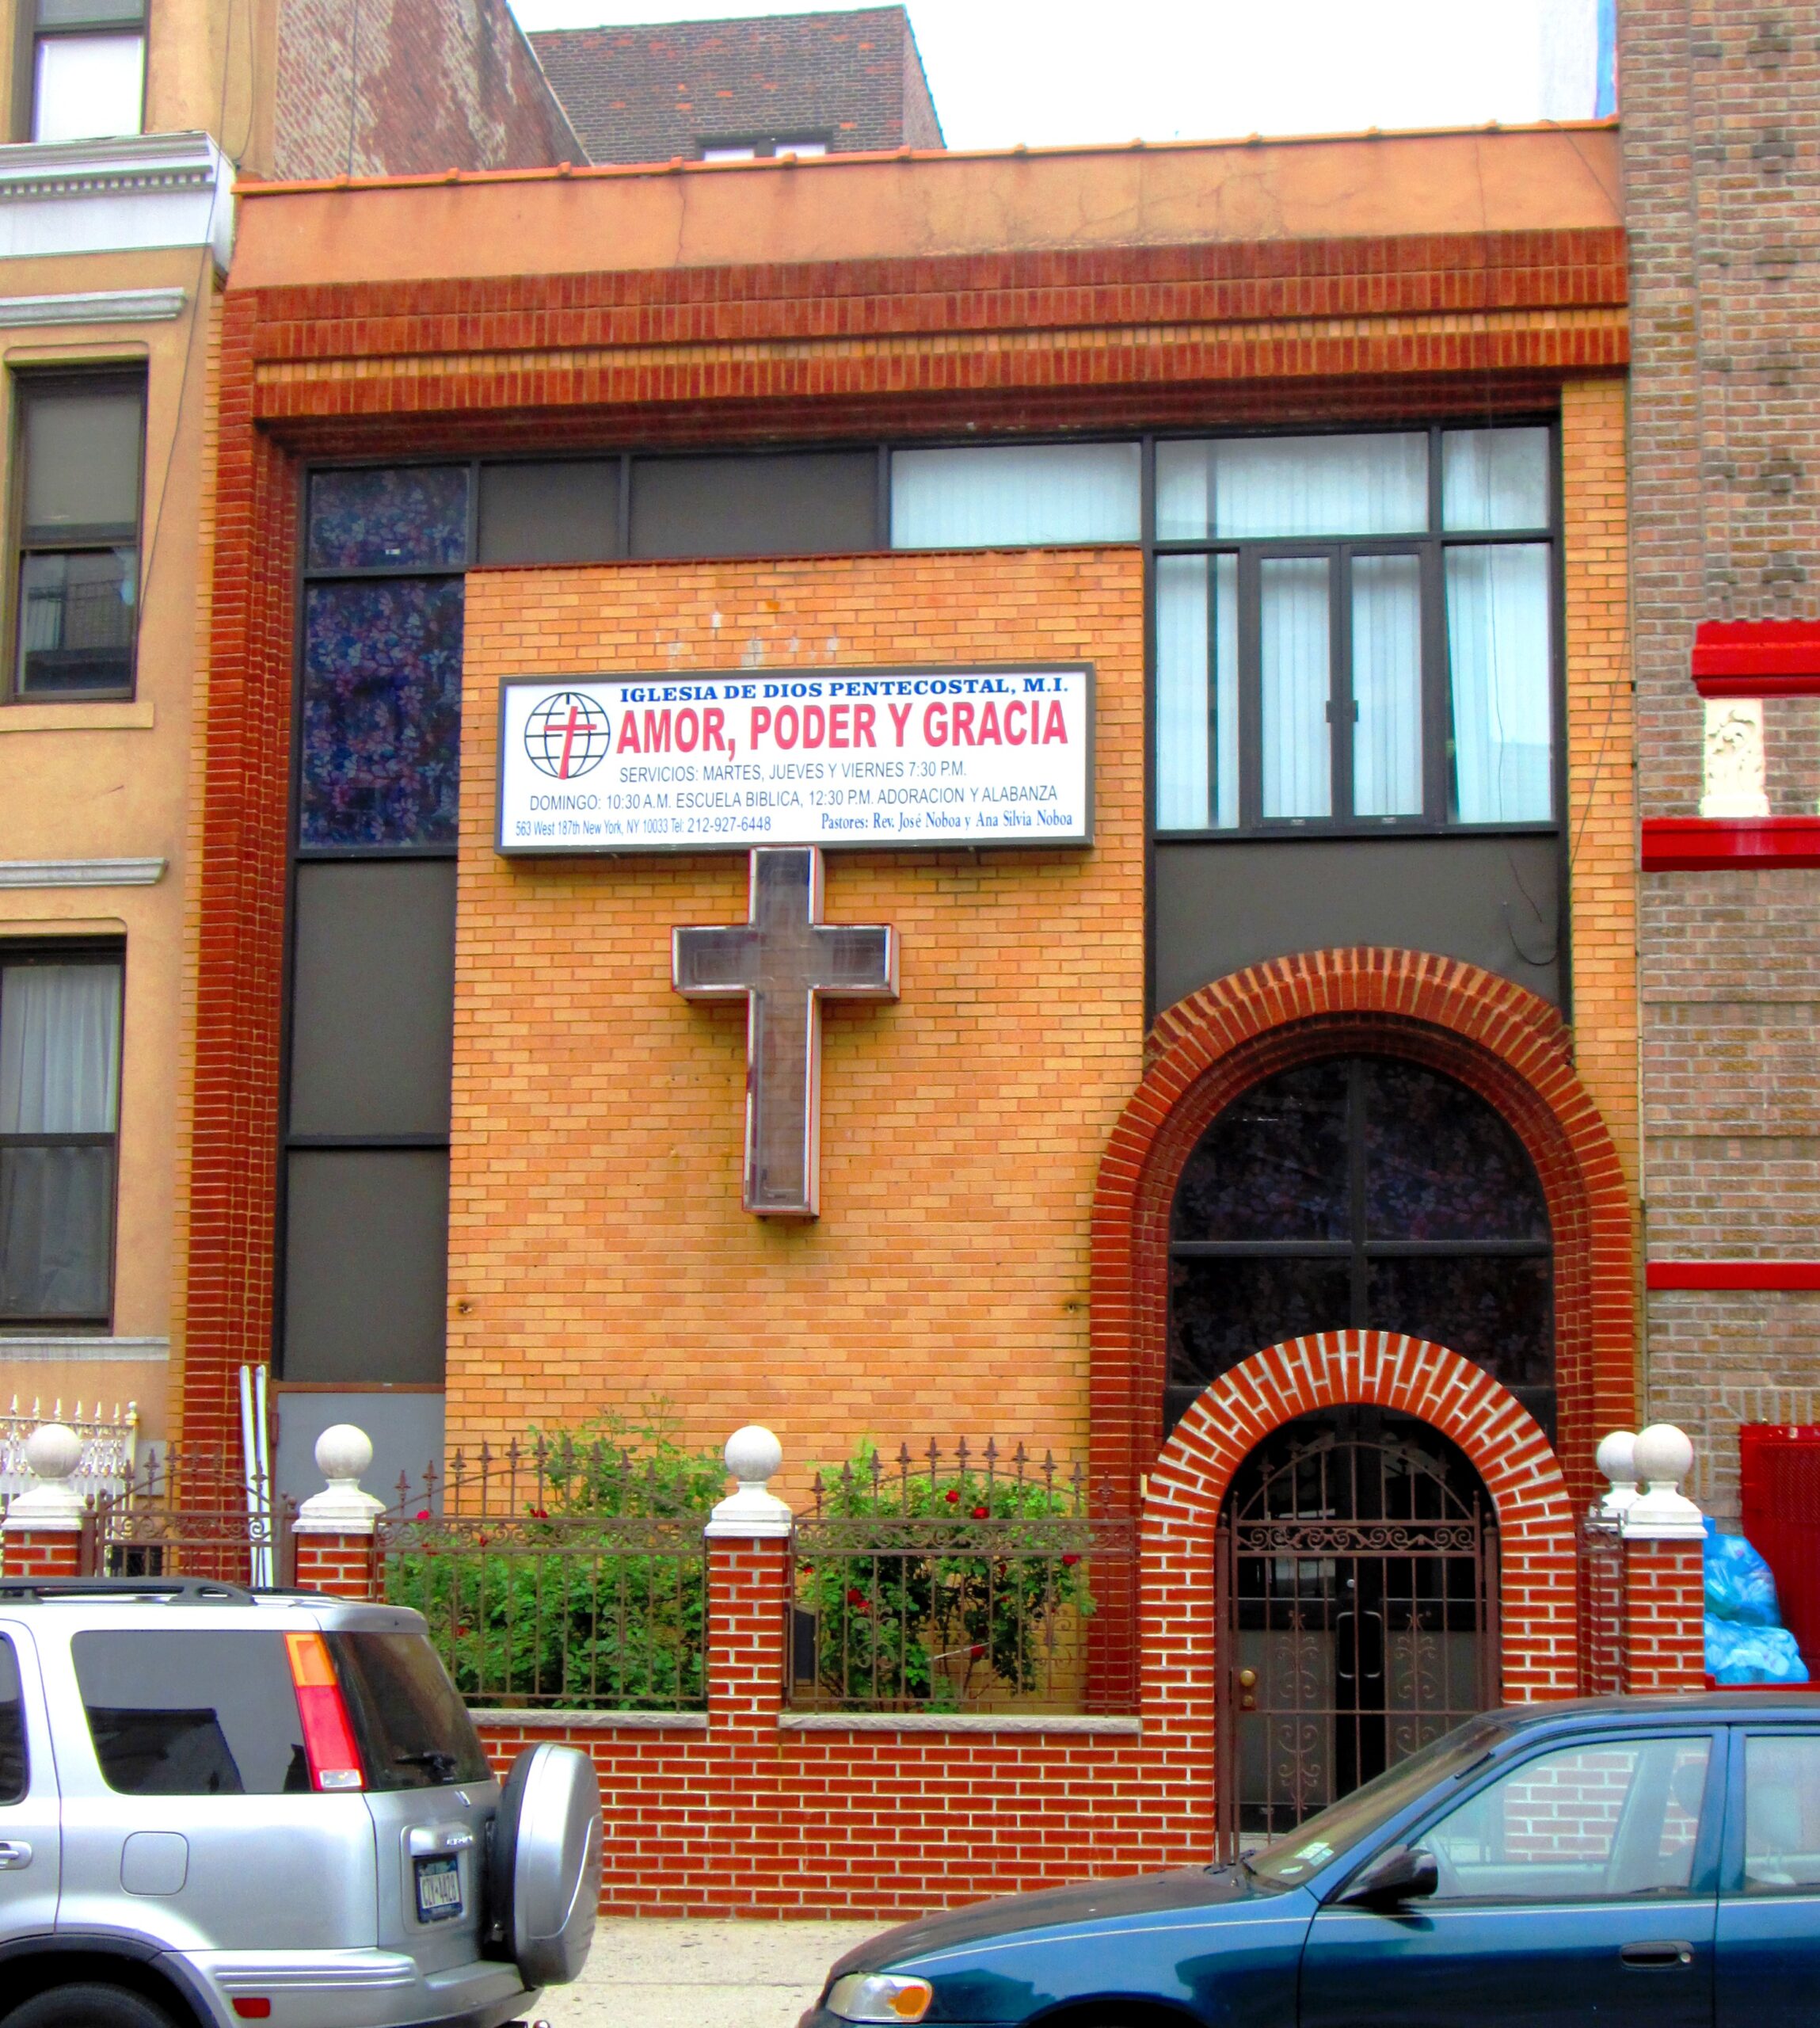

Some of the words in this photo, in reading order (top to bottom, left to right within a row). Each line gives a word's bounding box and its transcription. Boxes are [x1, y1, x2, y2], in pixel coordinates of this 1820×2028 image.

[620, 686, 718, 703] IGLESIA
[724, 684, 756, 700] DE
[763, 683, 822, 698] DIOS
[829, 679, 1015, 696] PENTECOSTAL,
[1023, 677, 1068, 692] M.I.
[616, 707, 736, 762] AMOR,
[751, 703, 877, 749] PODER
[888, 703, 913, 747] Y
[923, 700, 1068, 747] GRACIA
[619, 766, 699, 783] SERVICIOS:
[702, 764, 764, 782] MARTES,
[769, 764, 824, 780] JUEVES
[828, 763, 837, 778] Y
[842, 762, 904, 778] VIERNES
[909, 761, 936, 776] 7:30
[941, 760, 967, 776] P.M.
[530, 795, 601, 810] DOMINGO:
[607, 794, 640, 810] 10:30
[643, 793, 672, 809] A.M.
[676, 792, 741, 808] ESCUELA
[746, 791, 803, 808] BIBLICA,
[809, 790, 843, 806] 12:30
[848, 789, 874, 805] P.M.
[878, 787, 965, 804] ADORACION
[970, 787, 980, 802] Y
[982, 785, 1058, 802] ALABANZA
[516, 821, 531, 836] 563
[534, 821, 555, 836] West
[558, 821, 580, 835] 187th
[583, 820, 602, 834] New
[604, 819, 624, 836] York,
[626, 819, 640, 834] NY
[643, 818, 668, 833] 10033
[671, 818, 685, 833] Tel:
[687, 817, 771, 833] 212-927-6448
[821, 812, 869, 829] Pastores:
[873, 811, 895, 829] Rev.
[898, 811, 922, 832] José
[926, 810, 961, 828] Noboa
[965, 816, 972, 830] y
[976, 810, 999, 827] Ana
[1003, 810, 1032, 827] Silvia
[1037, 809, 1072, 826] Noboa
